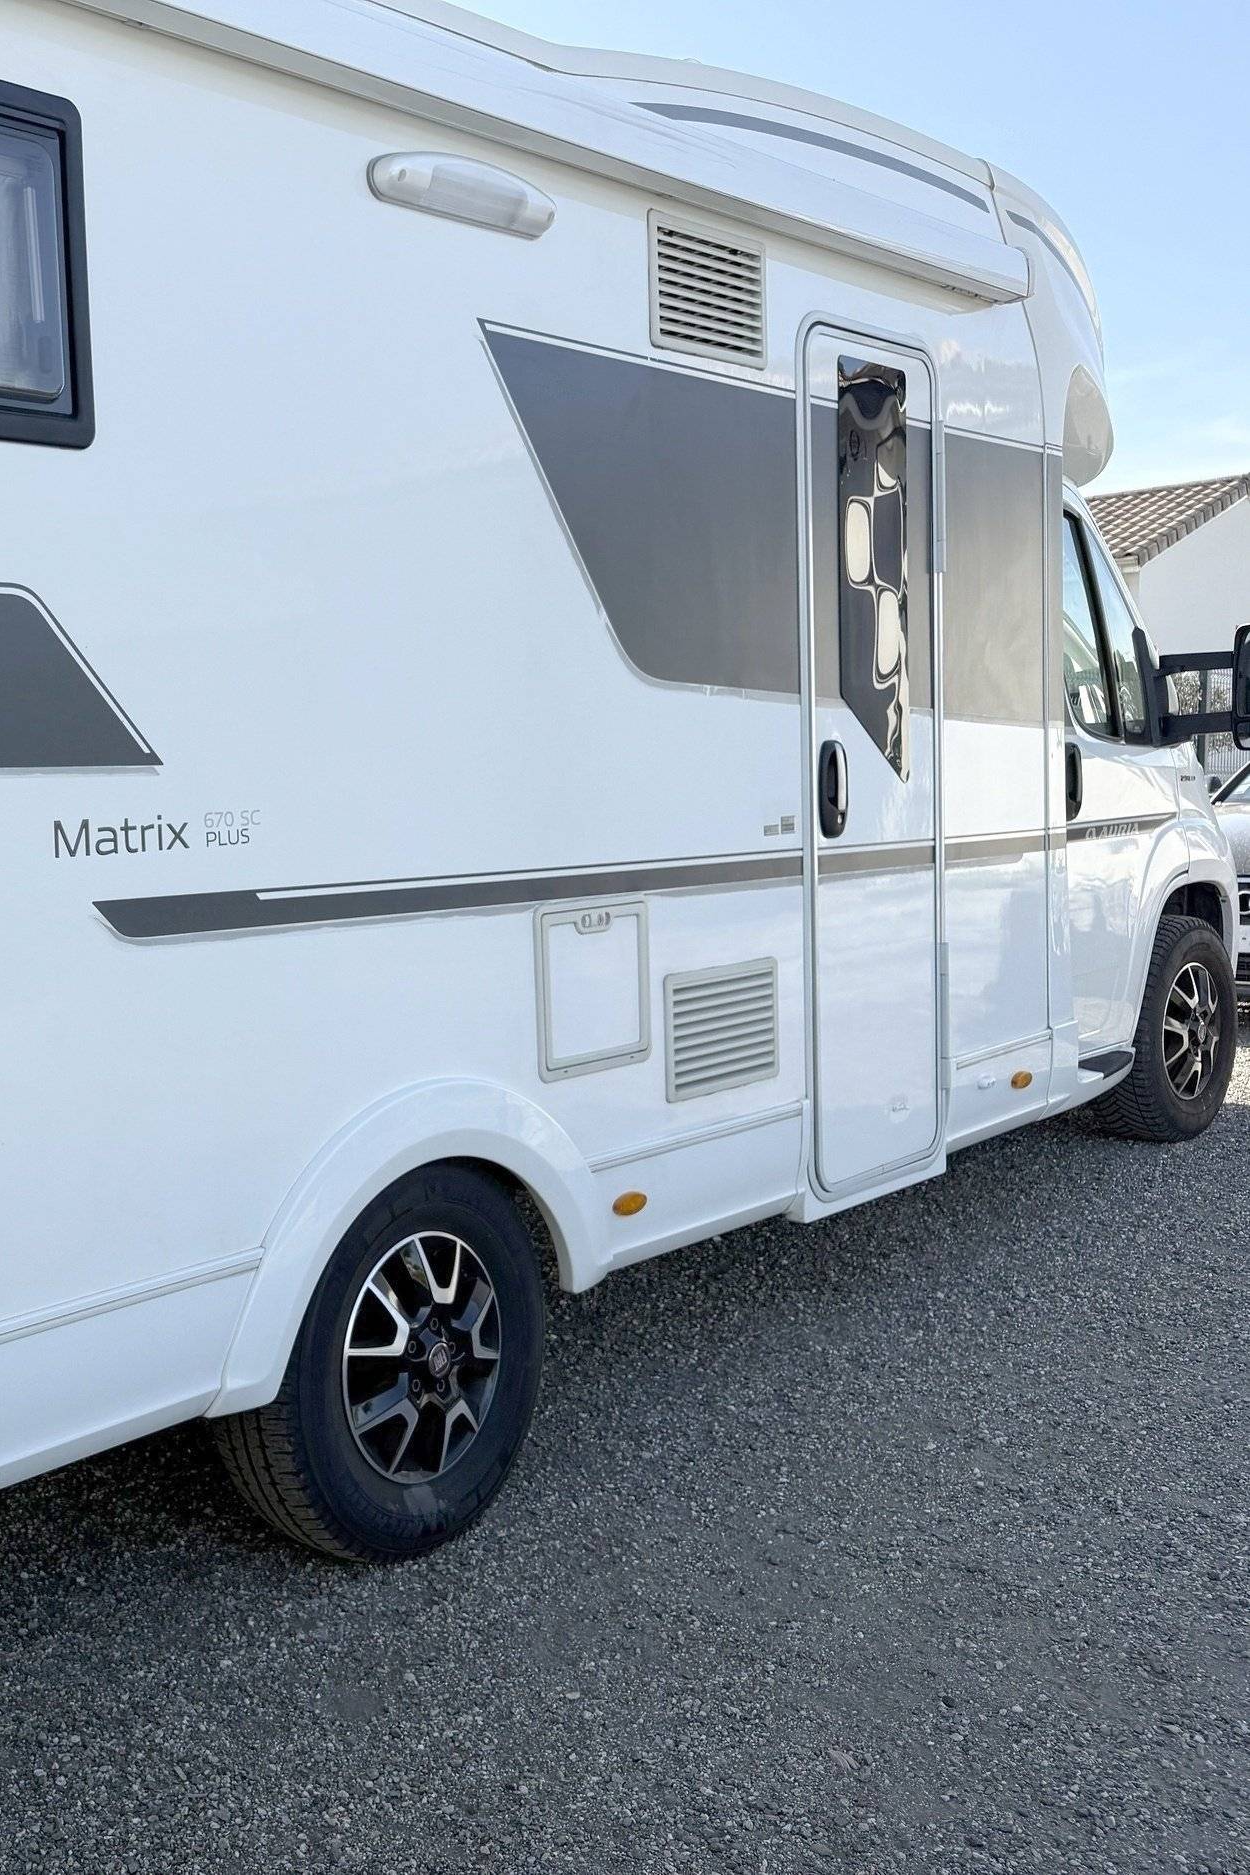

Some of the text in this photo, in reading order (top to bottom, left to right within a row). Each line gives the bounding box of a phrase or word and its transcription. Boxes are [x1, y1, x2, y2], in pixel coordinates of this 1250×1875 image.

[203, 809, 262, 828] 670 SC
[53, 814, 191, 858] Matrix
[205, 828, 251, 848] PLUS
